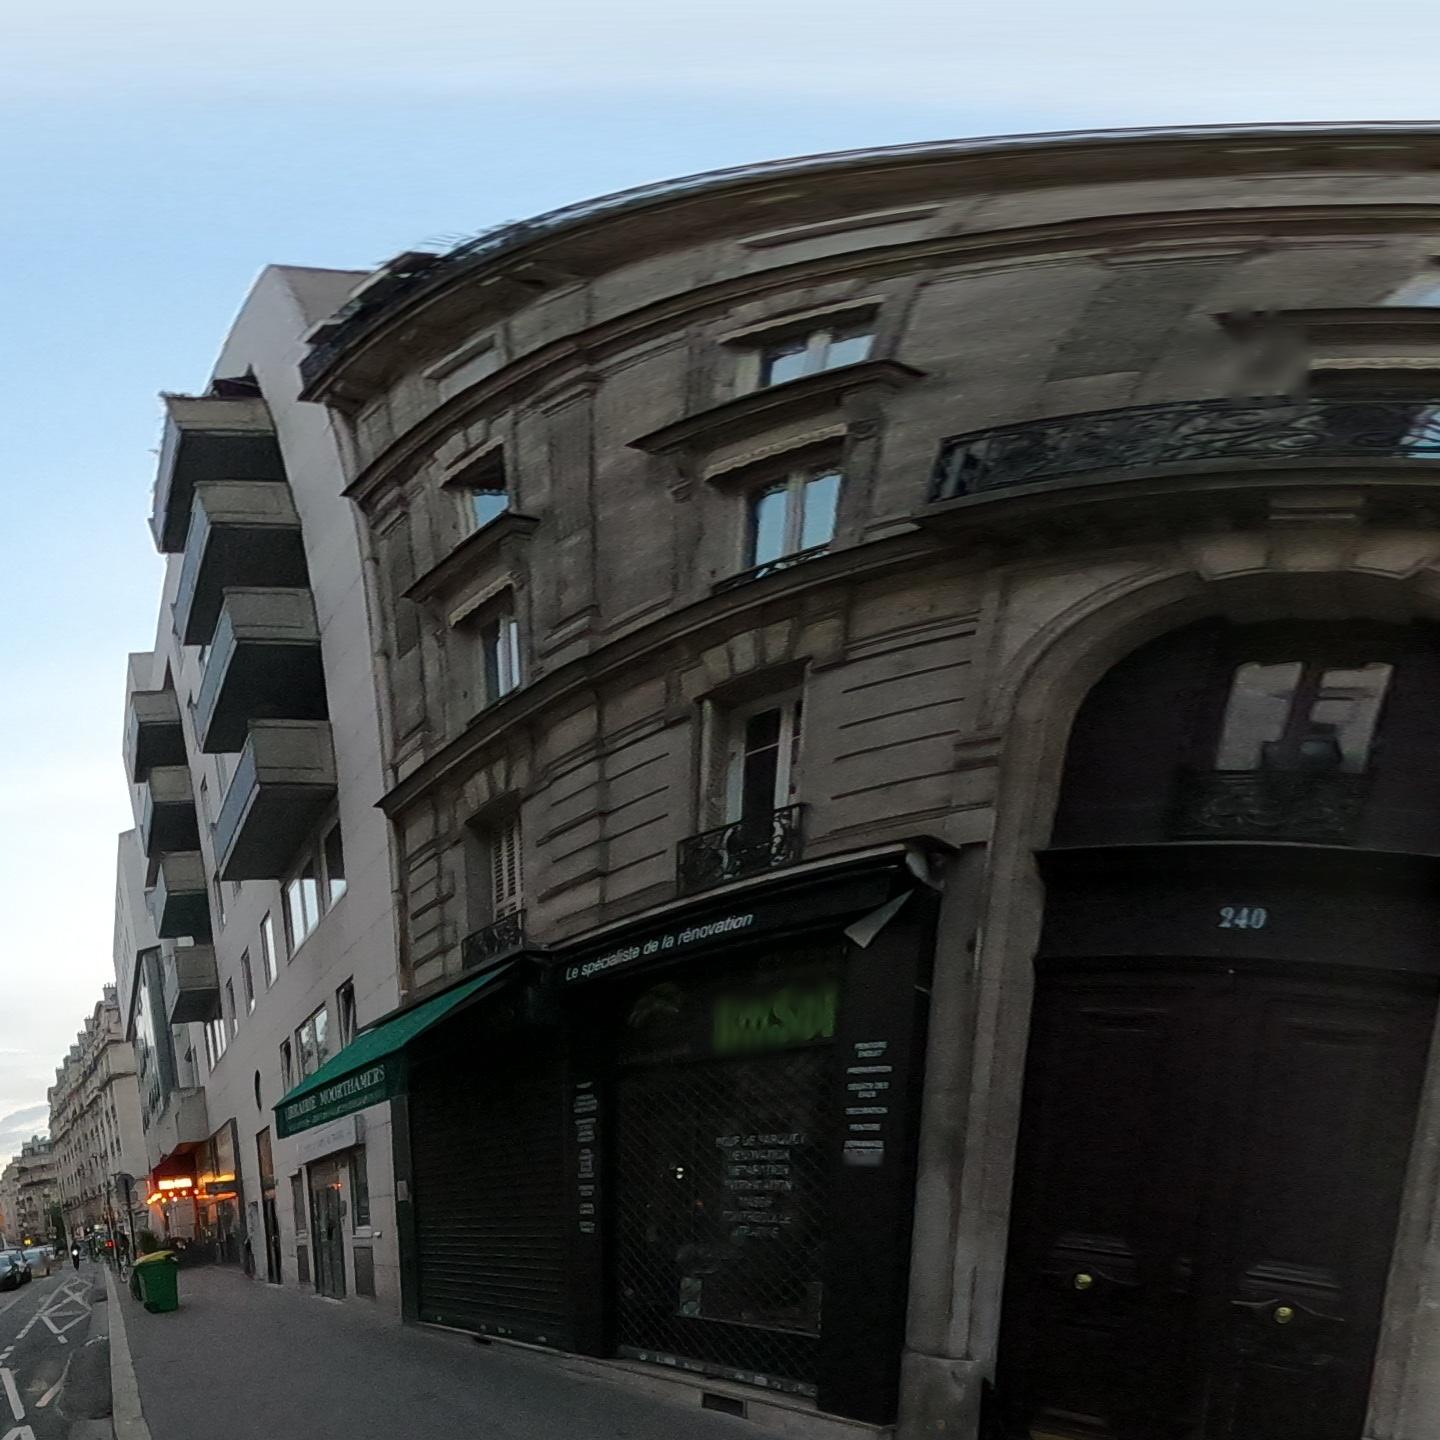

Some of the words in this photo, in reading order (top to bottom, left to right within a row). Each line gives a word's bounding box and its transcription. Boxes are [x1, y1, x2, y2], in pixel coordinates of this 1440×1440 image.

[1218, 907, 1267, 929] 240
[565, 967, 578, 980] Le
[581, 946, 640, 977] spécialiste
[643, 939, 659, 954] de
[661, 934, 674, 949] la
[678, 913, 754, 945] rénovation
